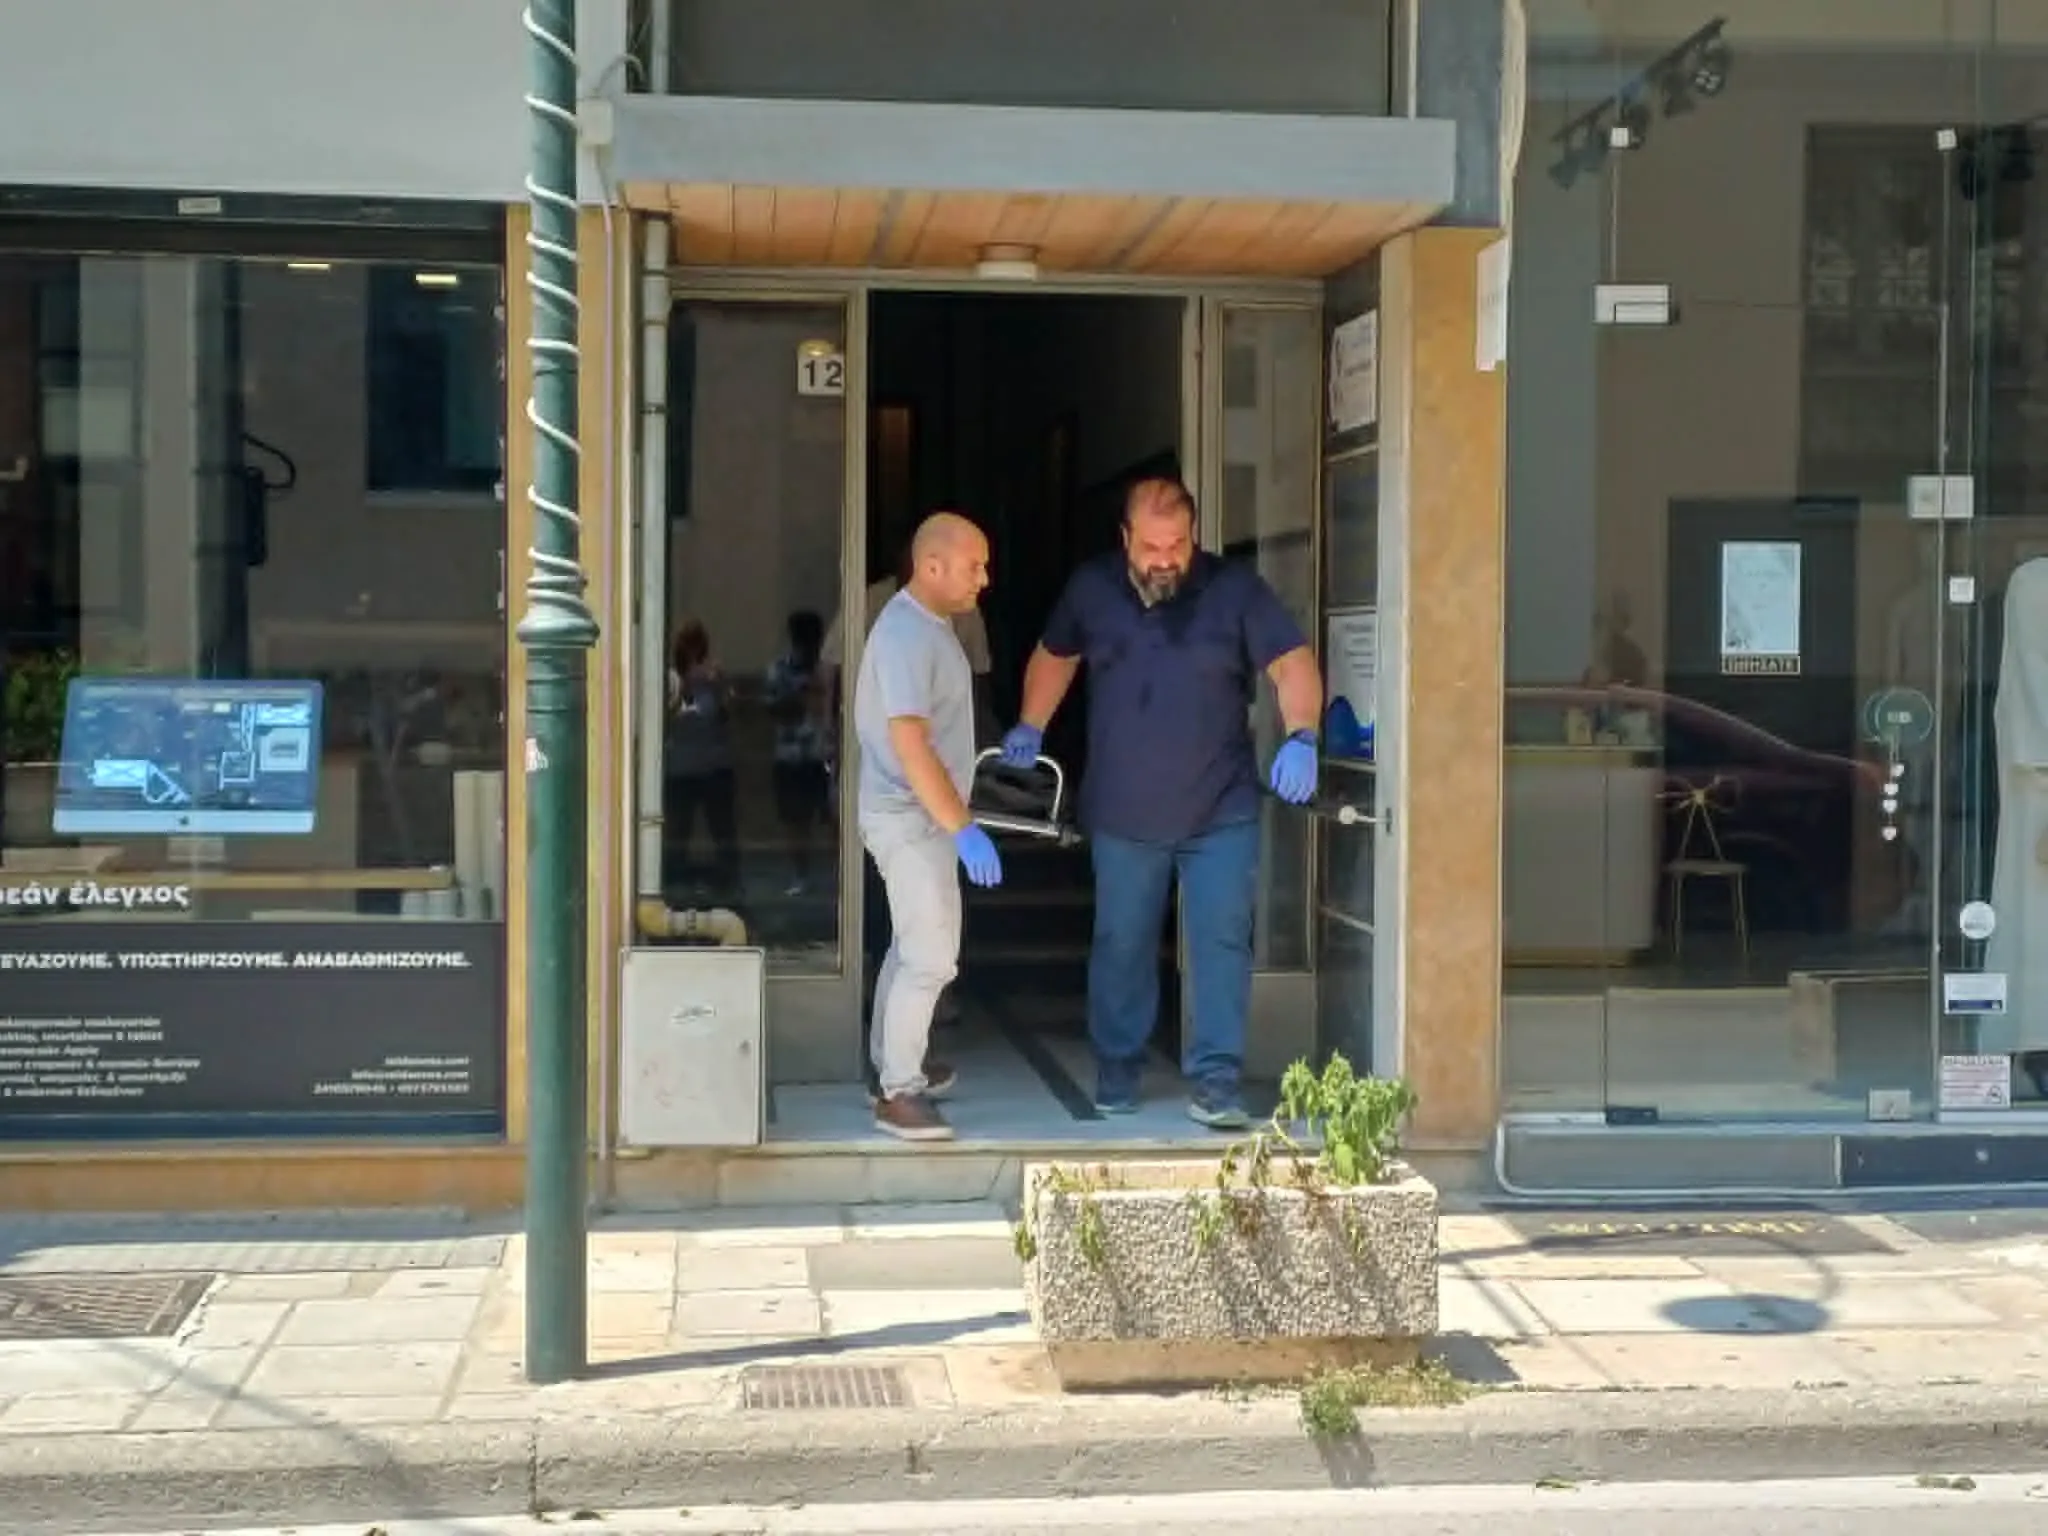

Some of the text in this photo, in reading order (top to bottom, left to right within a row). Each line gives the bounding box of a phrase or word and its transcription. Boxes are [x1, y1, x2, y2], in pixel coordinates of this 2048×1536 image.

[803, 359, 843, 388] 12
[0, 880, 190, 908] εάν έλεγχος
[117, 951, 288, 969] ΥΠΟΣΤΗΡΙΖΟΥΜΕ.
[293, 951, 472, 969] ΑΝΑΒΑΘΜΙΖΟΥΜΕ.
